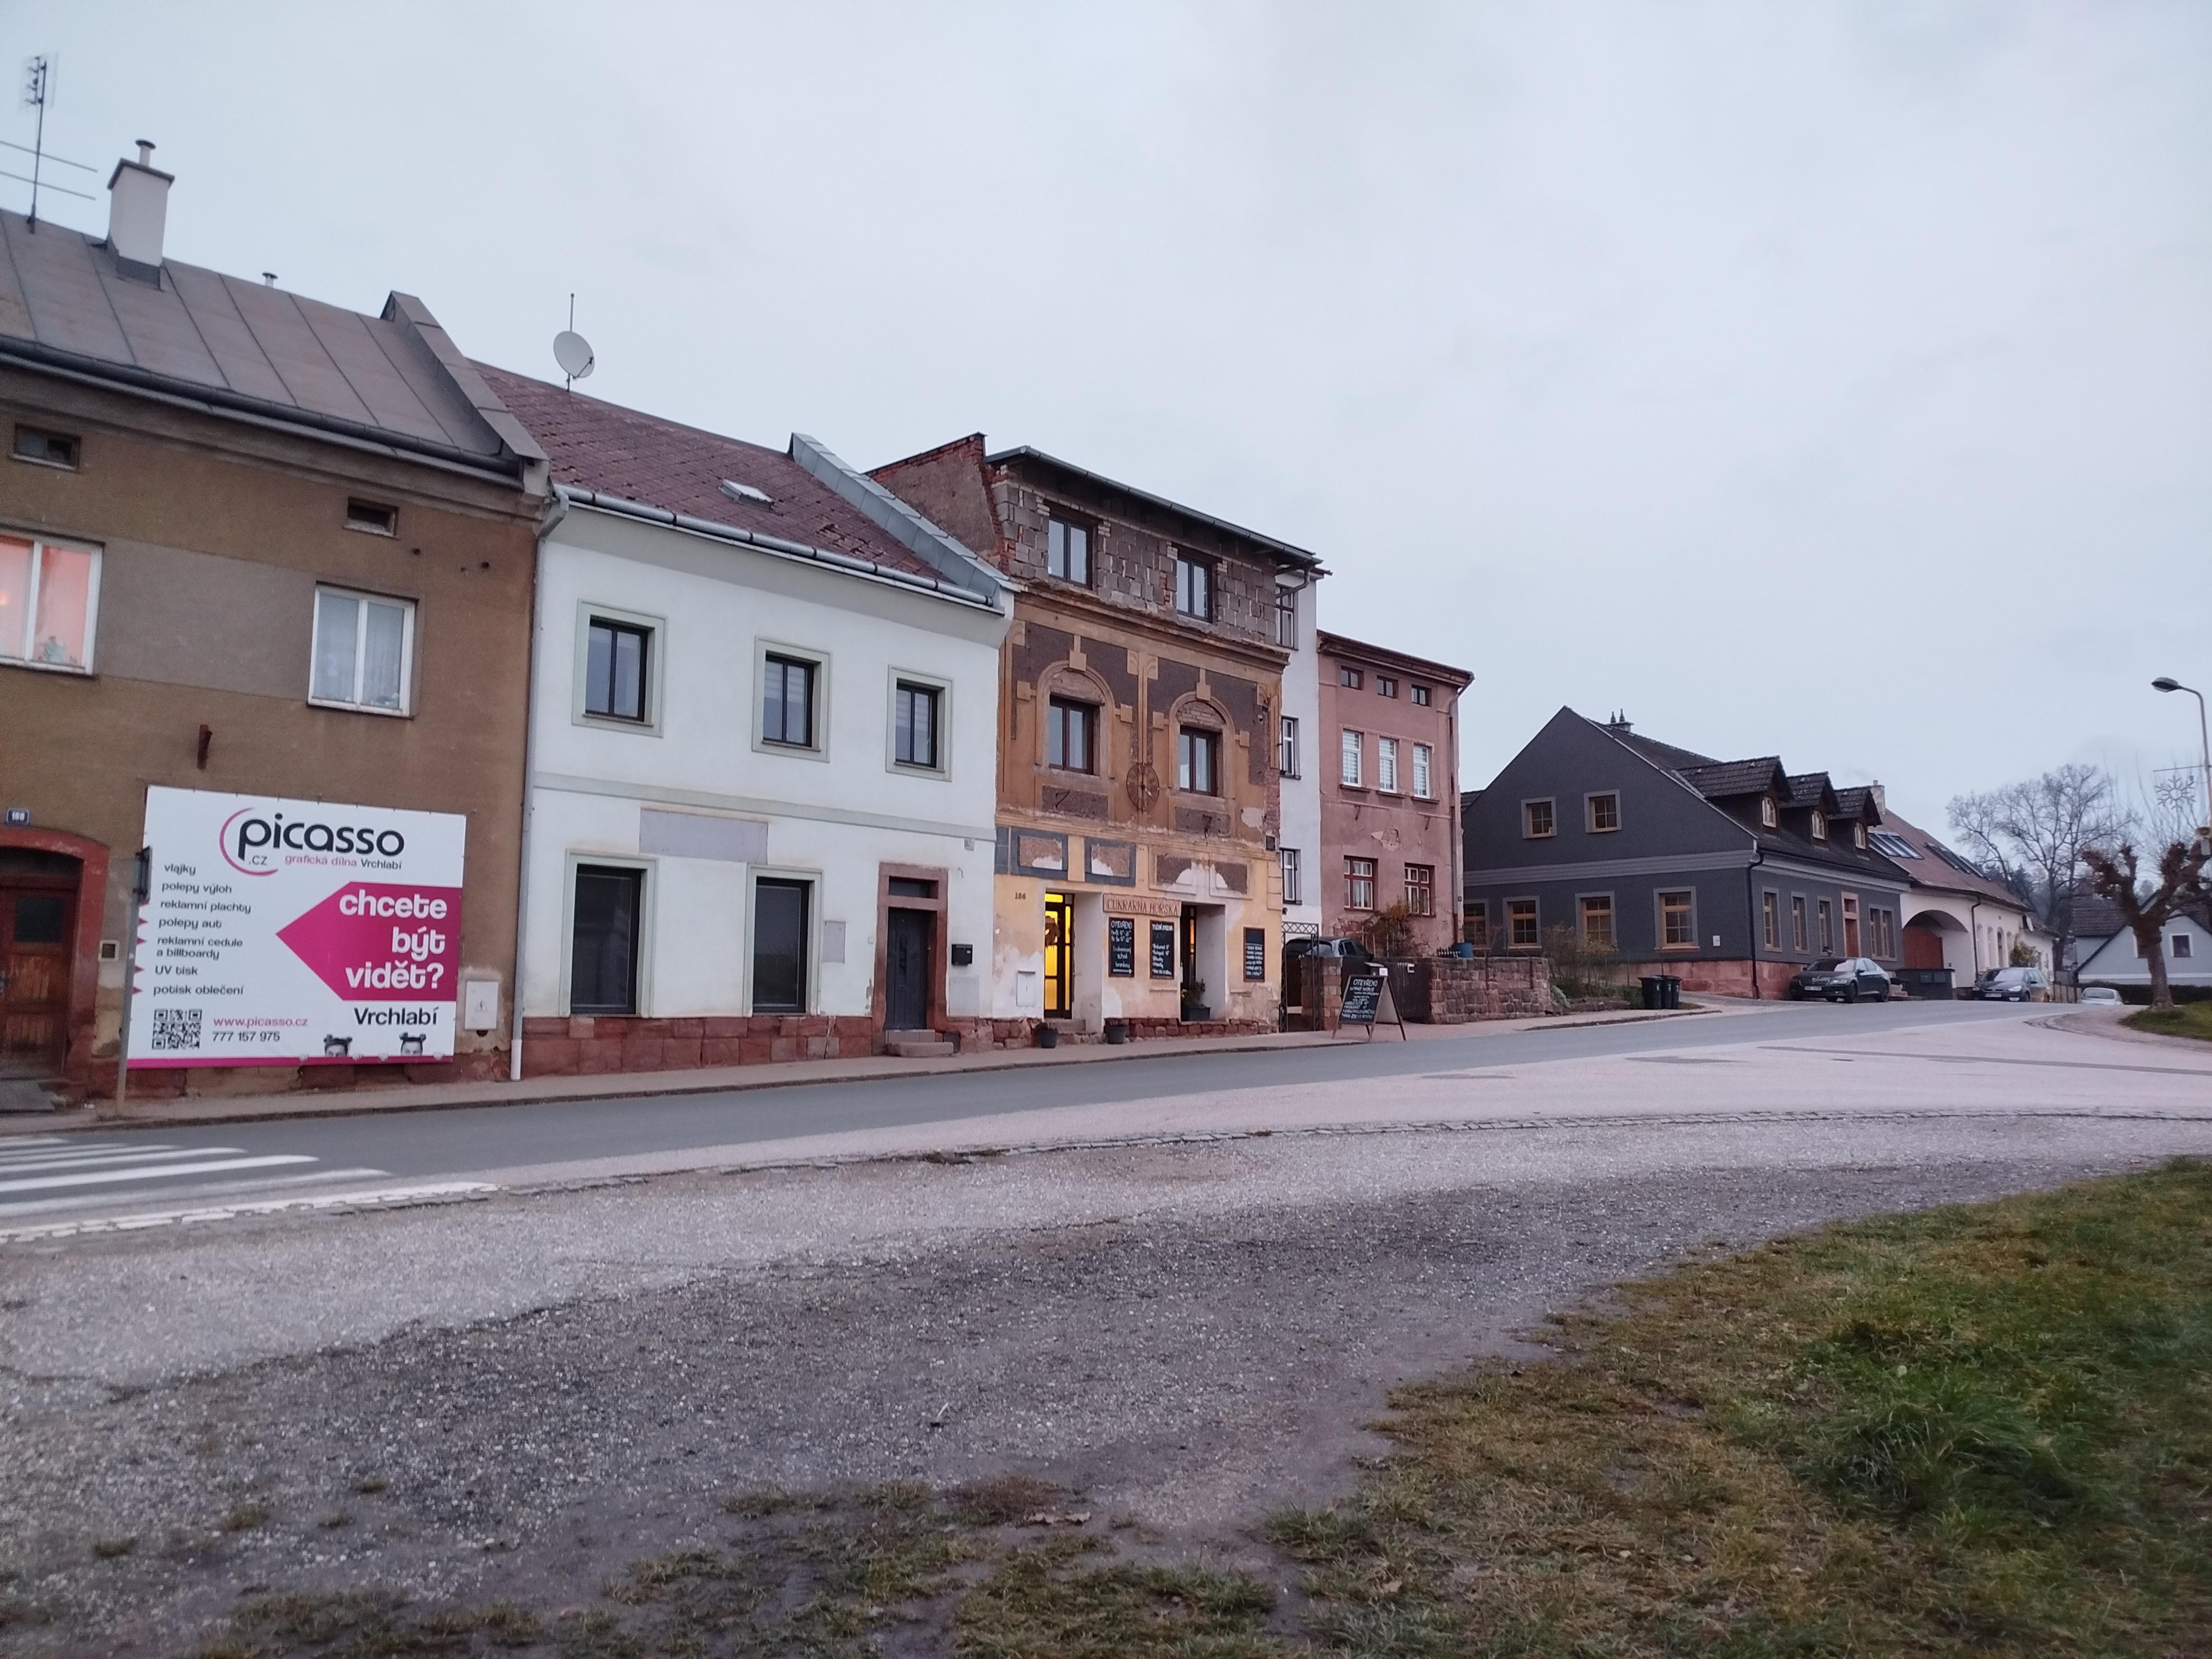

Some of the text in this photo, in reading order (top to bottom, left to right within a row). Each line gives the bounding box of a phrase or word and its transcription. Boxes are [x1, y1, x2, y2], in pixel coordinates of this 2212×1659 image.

[238, 813, 404, 861] picasso
[285, 854, 403, 870] grafická dílna Vrchlabí
[165, 863, 196, 876] vlajky
[161, 882, 232, 895] polepy výloh
[160, 900, 251, 915] reklamní plachty
[339, 889, 447, 920] chcete
[159, 917, 222, 930] polepy aut
[157, 936, 243, 947] reklamní cedule
[392, 925, 446, 962] být
[156, 948, 220, 961] a billboardy
[155, 965, 198, 975] UV tisk
[345, 959, 444, 989] vidět?
[153, 984, 244, 997] potisk oblečení
[354, 1006, 439, 1025] Vrchlabí
[213, 1016, 308, 1029] www.picasso.cz
[212, 1031, 234, 1042] 777
